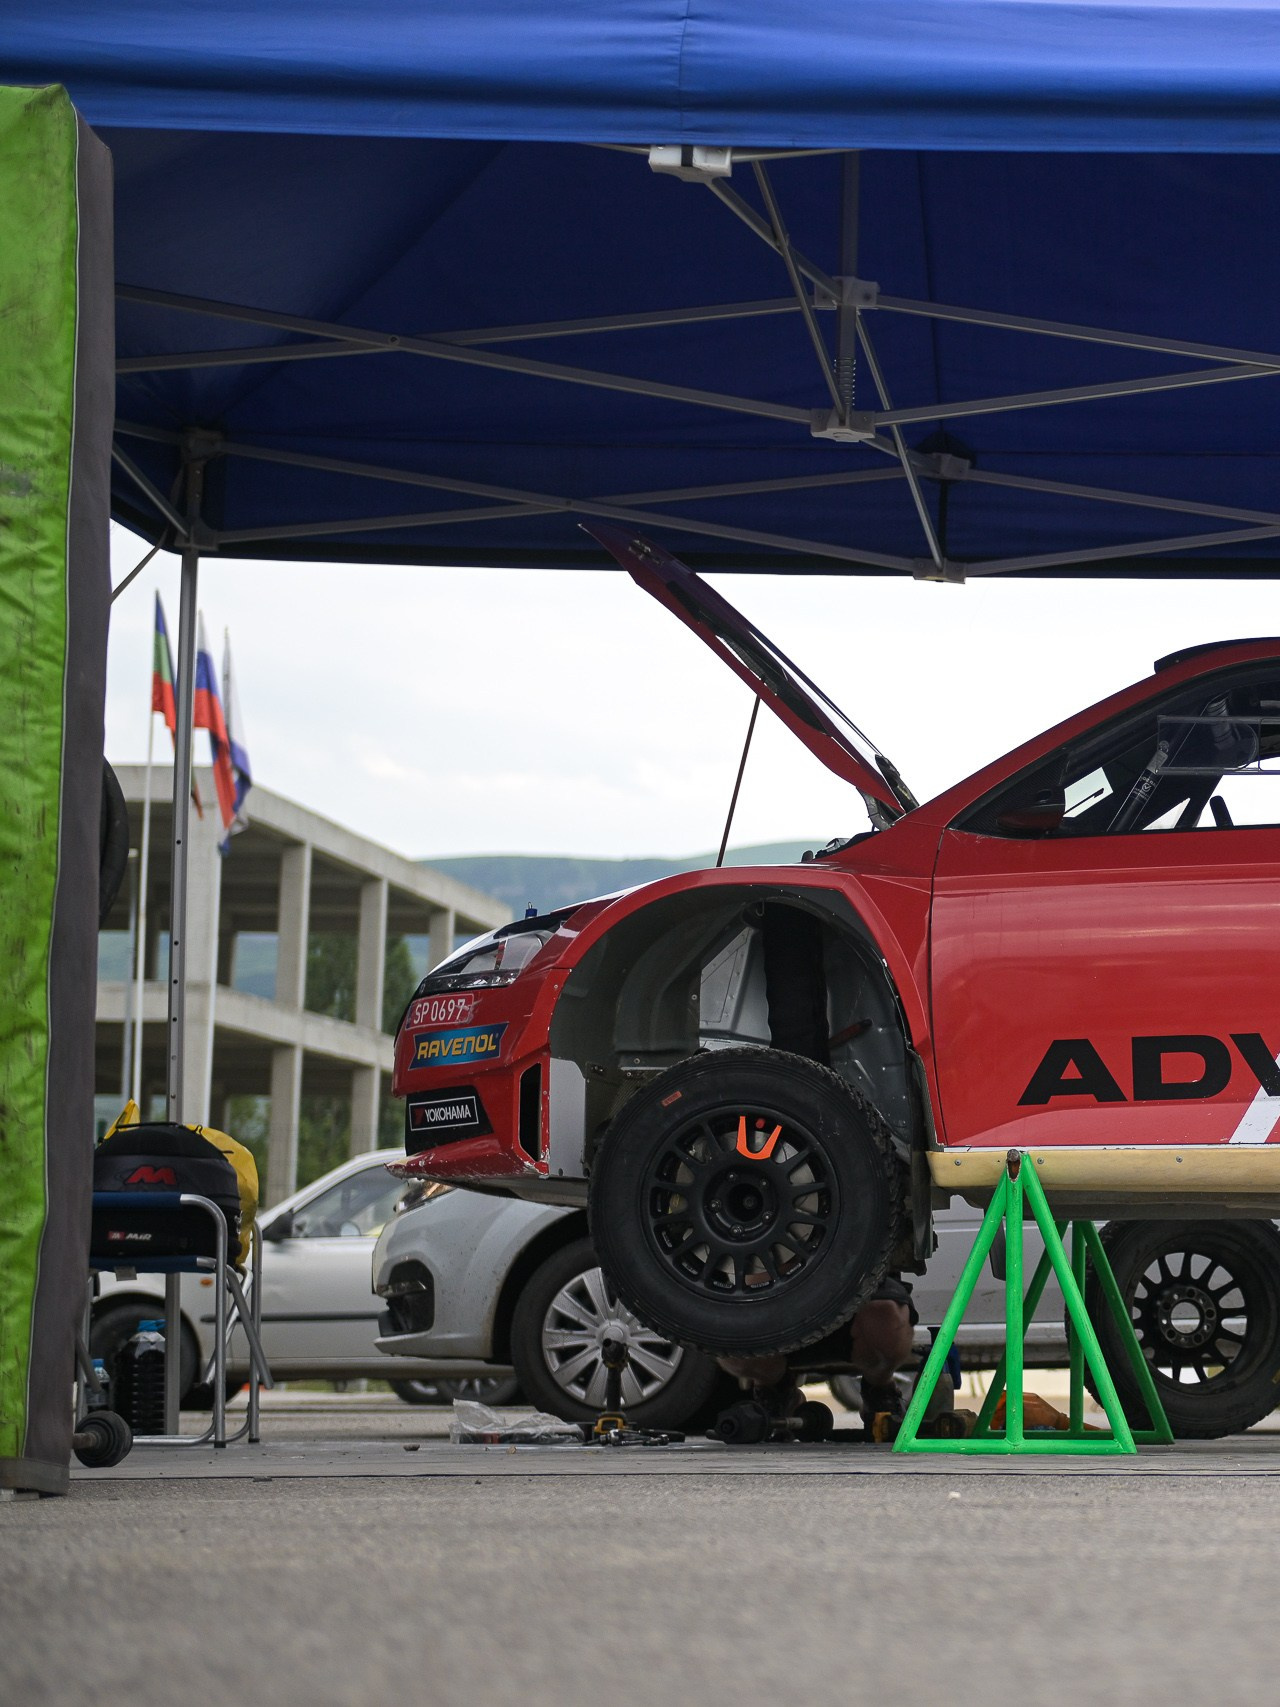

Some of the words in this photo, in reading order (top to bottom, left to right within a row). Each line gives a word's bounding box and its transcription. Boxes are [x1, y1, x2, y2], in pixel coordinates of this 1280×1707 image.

[413, 1002, 430, 1025] SP
[430, 998, 466, 1022] 0697
[417, 1033, 497, 1060] RAVENOL
[424, 1104, 472, 1123] YOKOHAMA
